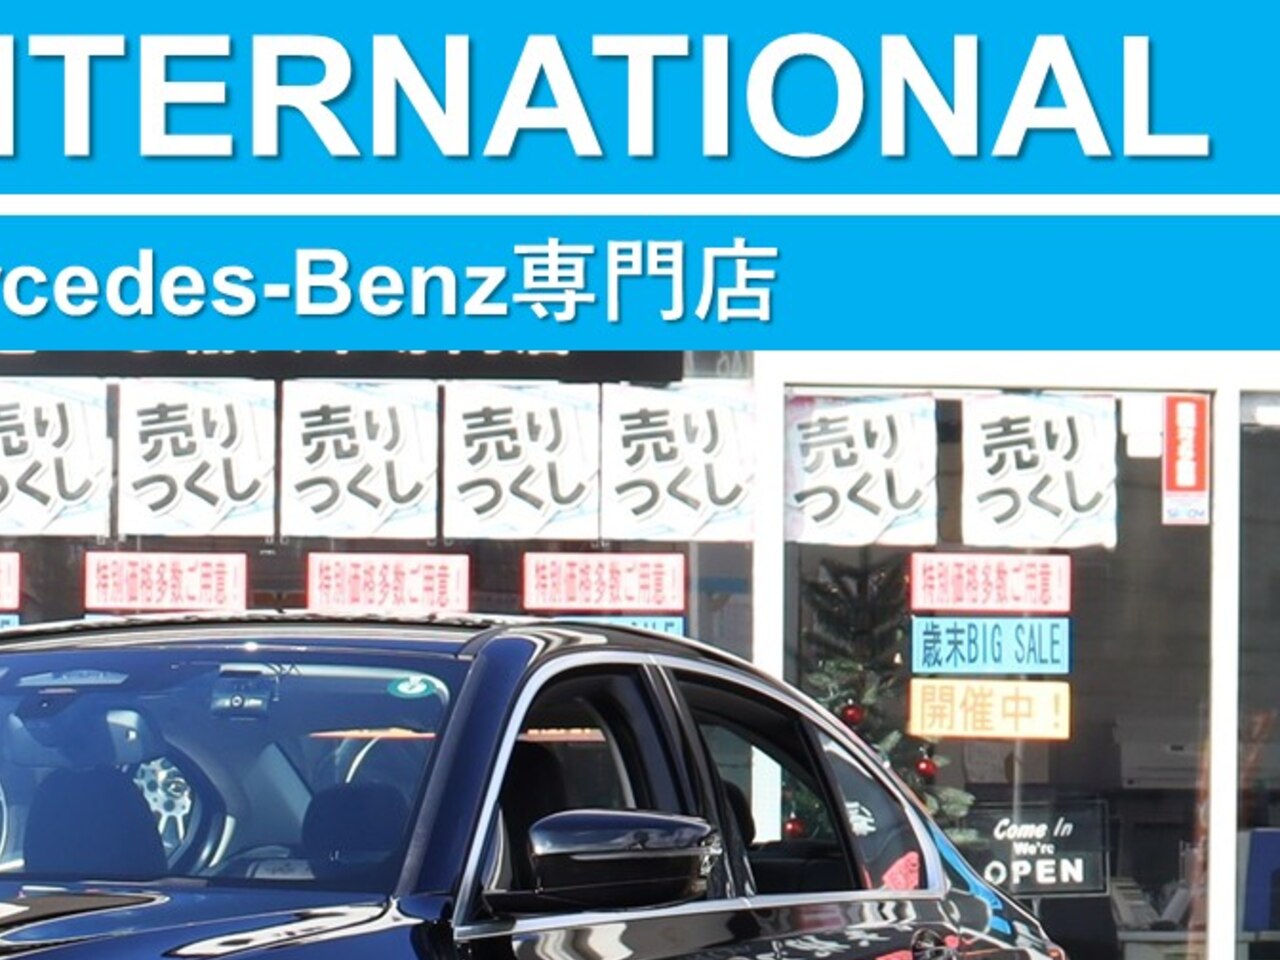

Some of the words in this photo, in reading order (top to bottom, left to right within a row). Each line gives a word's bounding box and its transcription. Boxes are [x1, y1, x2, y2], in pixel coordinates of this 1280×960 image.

[136, 403, 238, 462] 売り
[300, 404, 400, 464] 売り
[462, 406, 563, 466] 売り
[620, 408, 720, 466] 売り
[797, 414, 898, 473] 売り
[980, 415, 1080, 475] 売り
[131, 457, 261, 512] つくし
[294, 460, 424, 514] つくし
[457, 461, 586, 515] つくし
[615, 463, 743, 516] つくし
[794, 468, 923, 522] つくし
[976, 470, 1103, 524] つくし
[922, 621, 1004, 668] 歳末BIG
[1014, 622, 1061, 665] SALE
[993, 817, 1048, 841] Come
[1053, 816, 1074, 837] In
[1013, 841, 1055, 856] We're
[984, 858, 1083, 886] OPEN
